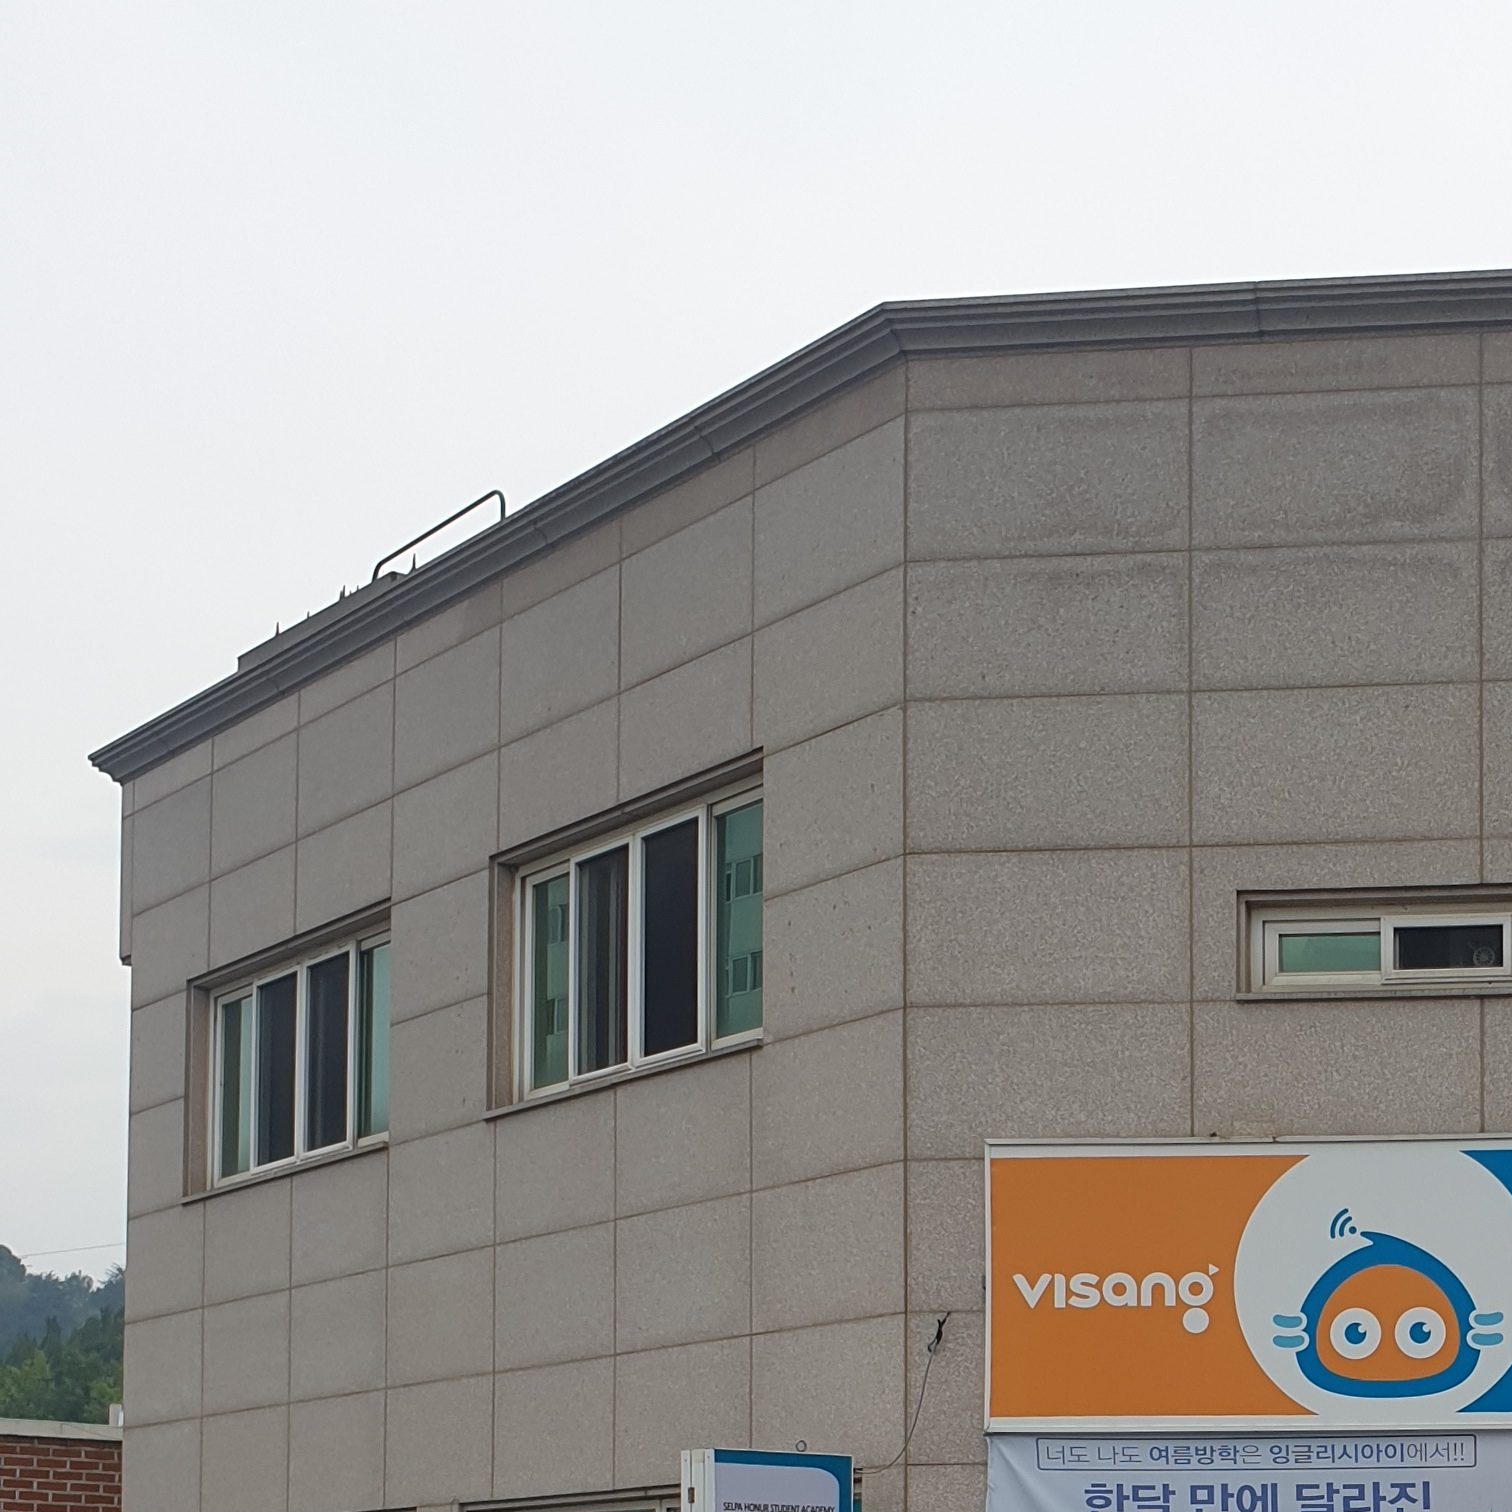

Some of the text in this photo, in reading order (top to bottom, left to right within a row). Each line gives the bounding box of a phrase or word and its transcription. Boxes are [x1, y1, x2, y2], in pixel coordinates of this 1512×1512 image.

[1012, 1264, 1219, 1334] visang
[1046, 1442, 1465, 1465] 너도 나도 여름방학은 잉글리시아이에서!!
[723, 1502, 743, 1511] SELPA
